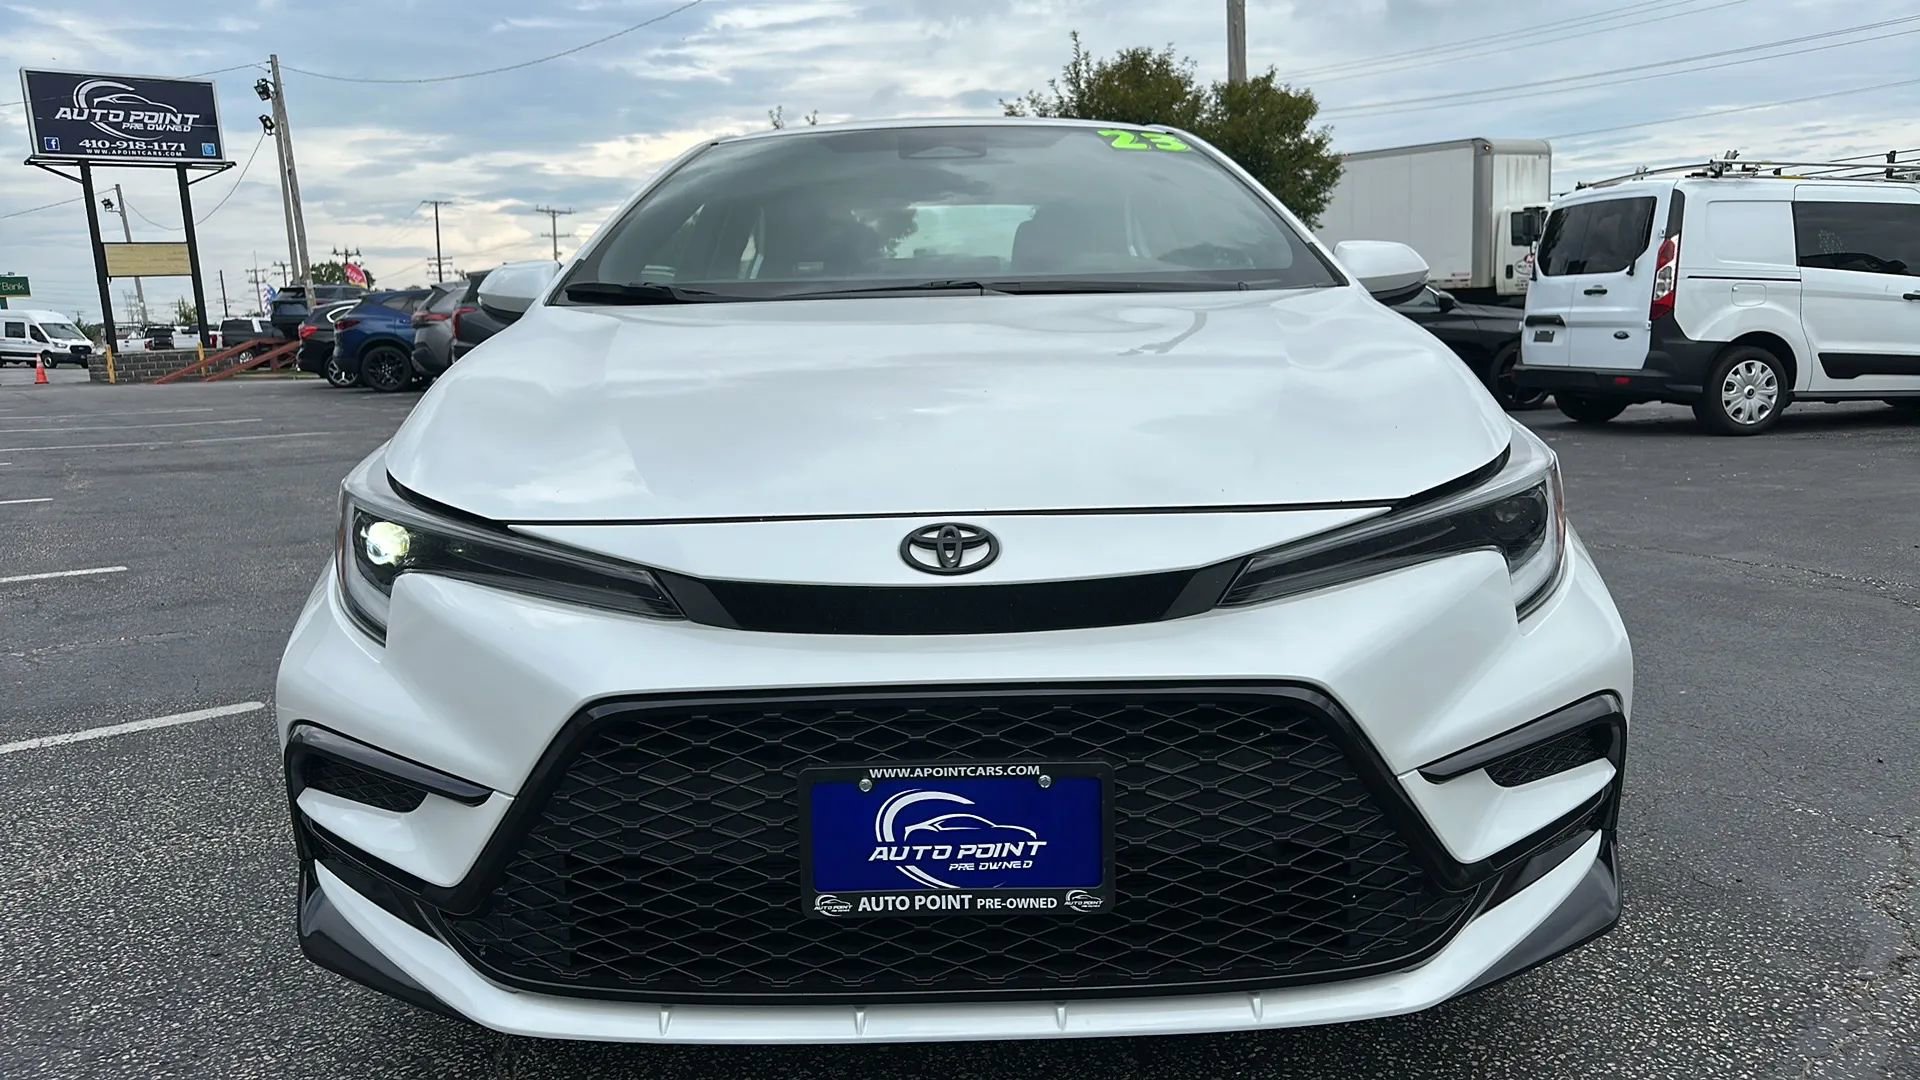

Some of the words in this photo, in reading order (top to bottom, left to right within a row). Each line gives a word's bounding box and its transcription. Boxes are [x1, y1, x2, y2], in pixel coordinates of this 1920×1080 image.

[55, 107, 125, 122] AUTO
[129, 111, 199, 125] POINT
[147, 124, 191, 132] OWNED
[79, 139, 187, 151] 410-918-1171
[1097, 130, 1191, 152] 23
[86, 149, 182, 157] WWW.APOINTCARS.COM
[2, 282, 24, 290] Bank
[869, 766, 1040, 778] WWW.APOINTCARS.COM
[868, 845, 952, 861] AUTO
[957, 841, 1047, 859] POINT
[949, 863, 975, 871] PRE
[979, 861, 1033, 870] OWNED
[858, 896, 910, 911] AUTO
[914, 895, 972, 910] POINT
[977, 898, 1057, 909] PRE-OWNED
